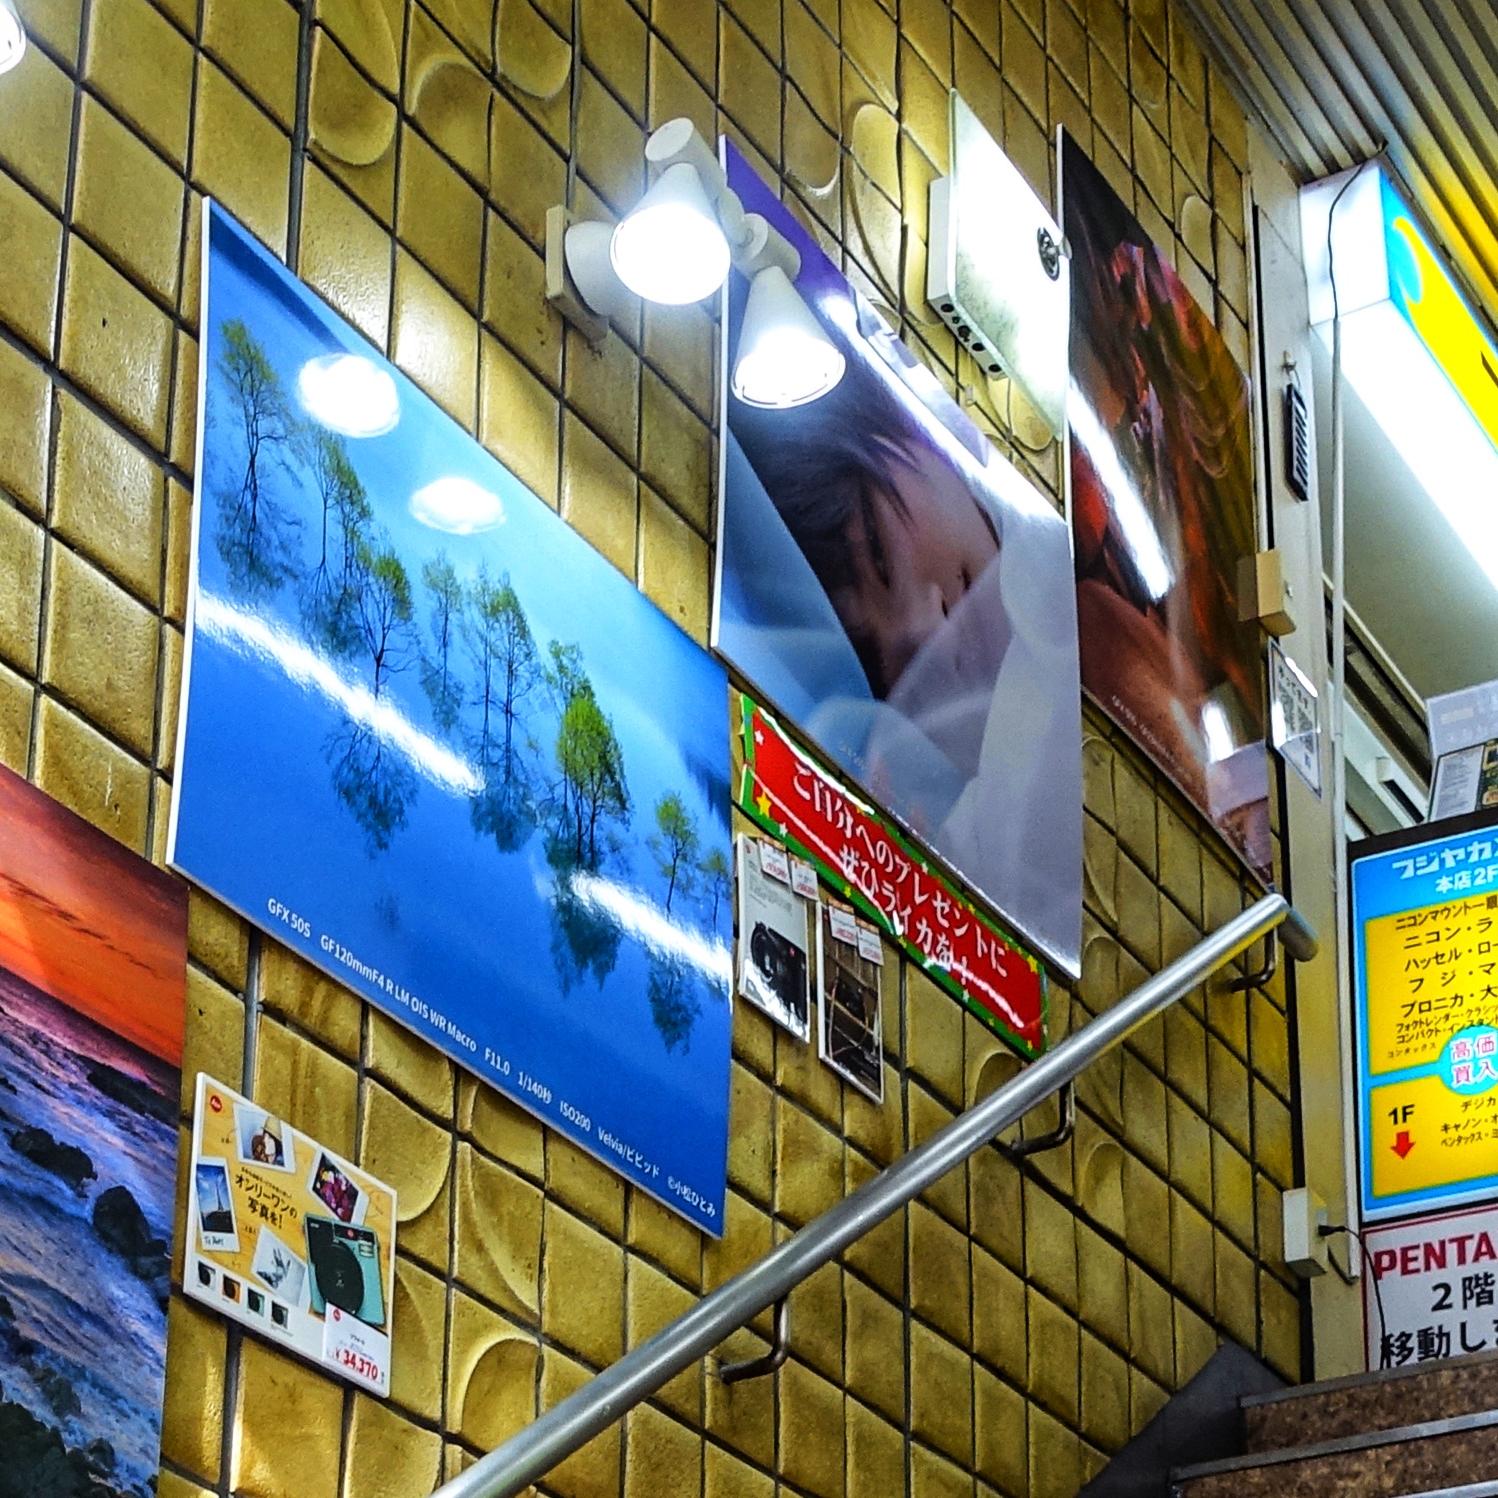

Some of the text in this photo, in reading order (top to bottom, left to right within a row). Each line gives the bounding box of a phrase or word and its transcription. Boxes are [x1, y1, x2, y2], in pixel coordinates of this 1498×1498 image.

[267, 897, 290, 924] GFX
[290, 913, 312, 938] 50S
[320, 934, 384, 991] GF120mmF4
[385, 979, 394, 995] R
[394, 985, 410, 1006] LM
[410, 997, 429, 1019] OIS
[430, 1009, 447, 1029] WR
[447, 1022, 477, 1052] Macro
[559, 1101, 591, 1132] ISO200
[1451, 1033, 1497, 1062] 高価
[1388, 1103, 1415, 1126] 1F
